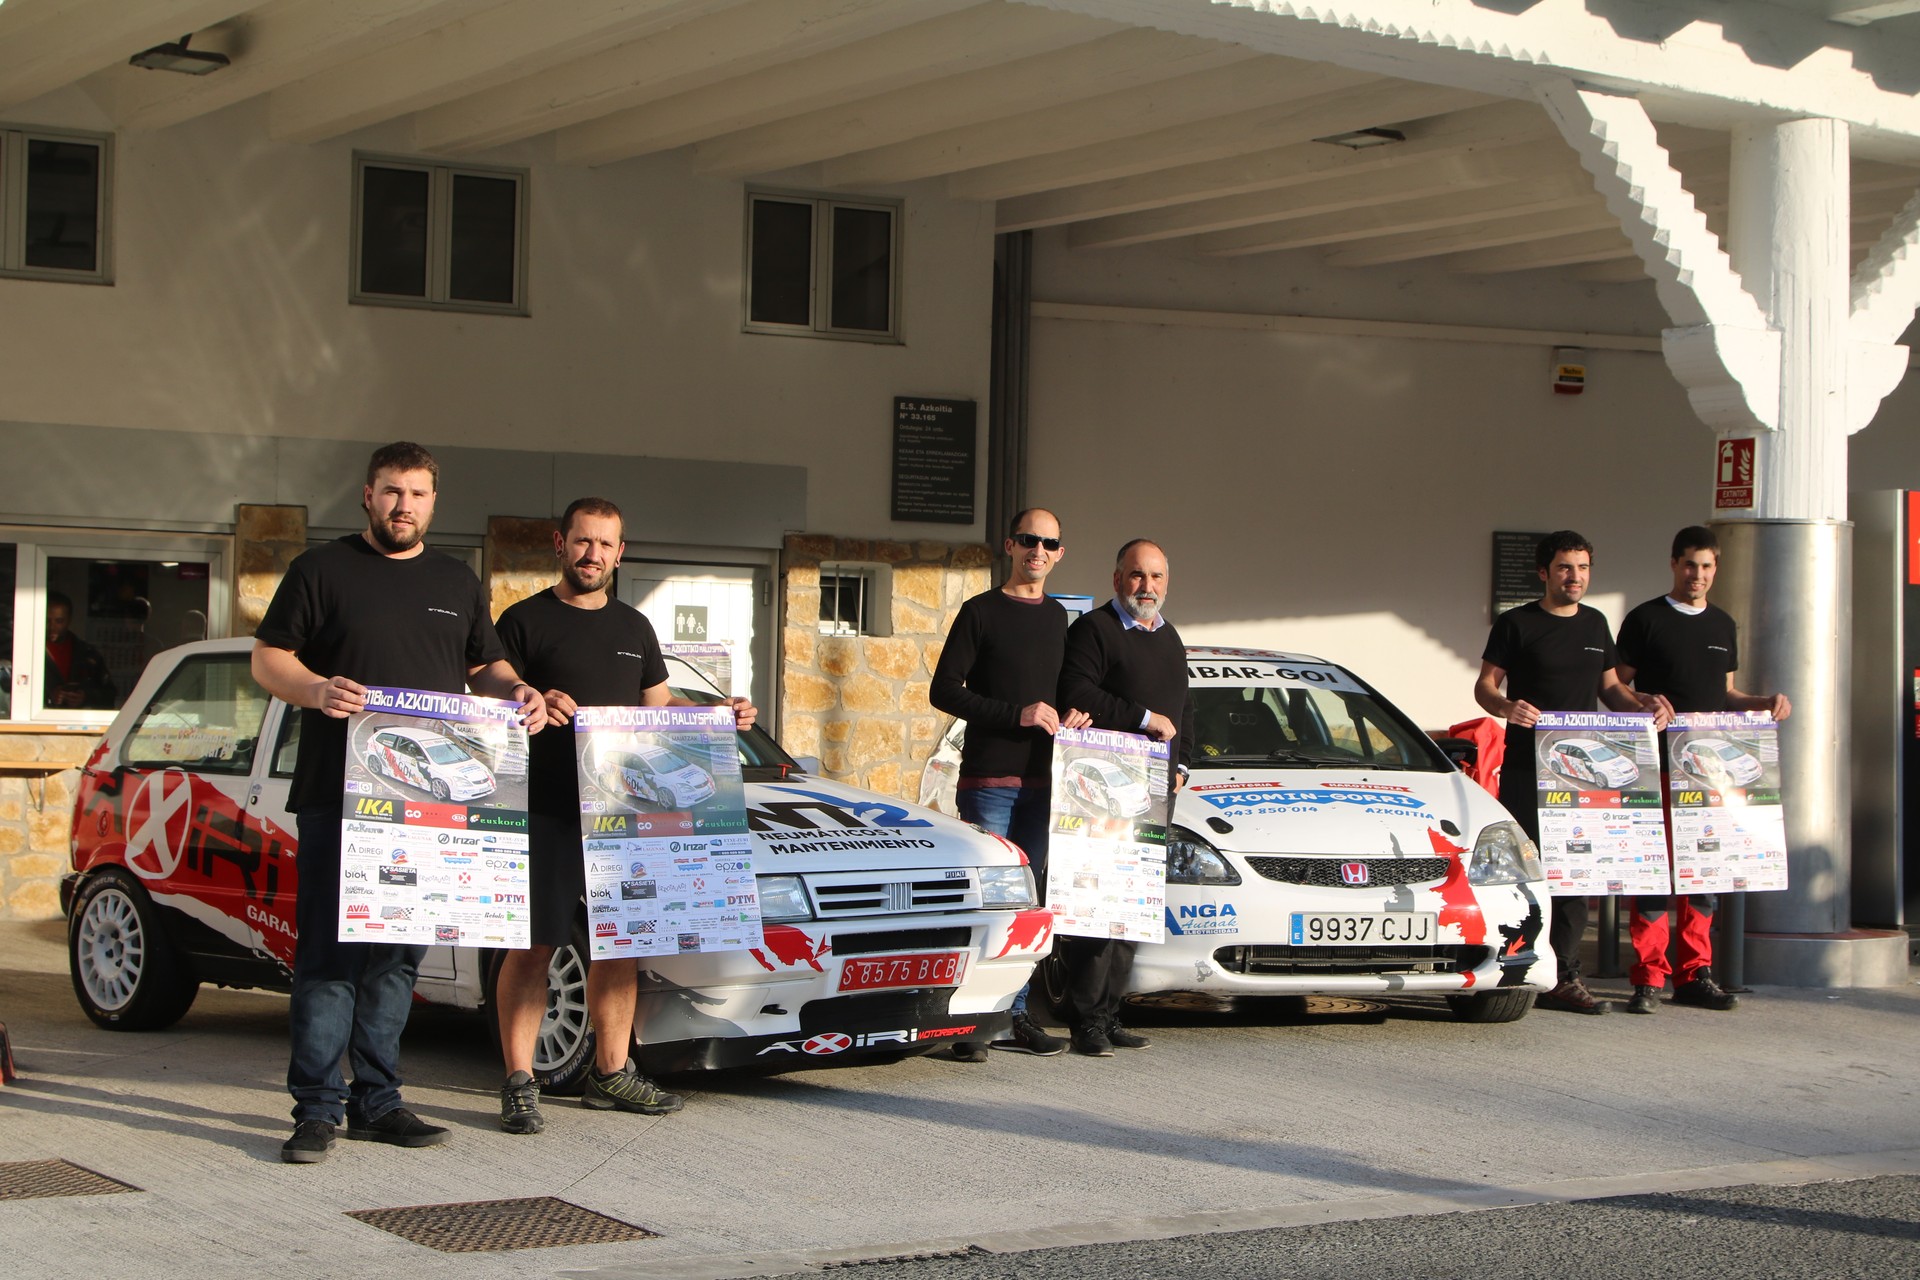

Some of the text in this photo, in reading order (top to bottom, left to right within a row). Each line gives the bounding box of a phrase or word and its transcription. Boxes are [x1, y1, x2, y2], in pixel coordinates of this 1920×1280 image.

[920, 403, 953, 413] Azkoitia
[910, 413, 937, 421] 33.165
[1722, 490, 1748, 498] EXTINTOR
[395, 691, 460, 715] AZKOITIKO
[613, 709, 670, 726] AZKOITIKO
[672, 711, 734, 726] RALLYSPRINTA
[1564, 713, 1607, 727] AZKOITIKO
[1693, 714, 1733, 727] AZKOITIKO
[1082, 729, 1124, 747] AZKOITIKO
[1211, 792, 1415, 805] TXOMIN-GORRI
[1546, 791, 1571, 803] IKA
[1679, 791, 1703, 803] IKA
[356, 798, 393, 816] IKA
[1224, 809, 1253, 817] 943
[405, 809, 422, 819] GO
[1365, 807, 1435, 820] AZKOITIA
[480, 816, 527, 827] euskorot
[593, 816, 627, 832] IKA
[637, 822, 652, 830] GO
[705, 817, 747, 828] euskorot
[1059, 815, 1083, 829] IKA
[452, 835, 480, 845] Irizar
[757, 828, 903, 841] NEUMÁTICOS Y
[358, 846, 384, 856] DIREGI
[683, 843, 708, 851] Irizar
[769, 839, 935, 855] MANTENIMIENTO
[1644, 854, 1665, 862] DTM
[389, 866, 417, 874] SASIETA
[600, 864, 623, 872] DIREGI
[945, 870, 967, 879] FIAT
[494, 893, 526, 904] DTM
[727, 894, 756, 905] DTM
[1146, 896, 1163, 906] DTM
[1181, 917, 1238, 929] Autoak
[1309, 917, 1374, 941] 9937
[1382, 917, 1428, 941] CJJ
[842, 958, 956, 986] S 8575 BCB
[918, 1025, 977, 1040] MOTORSPORT
[553, 1039, 590, 1084] MICHELIN
